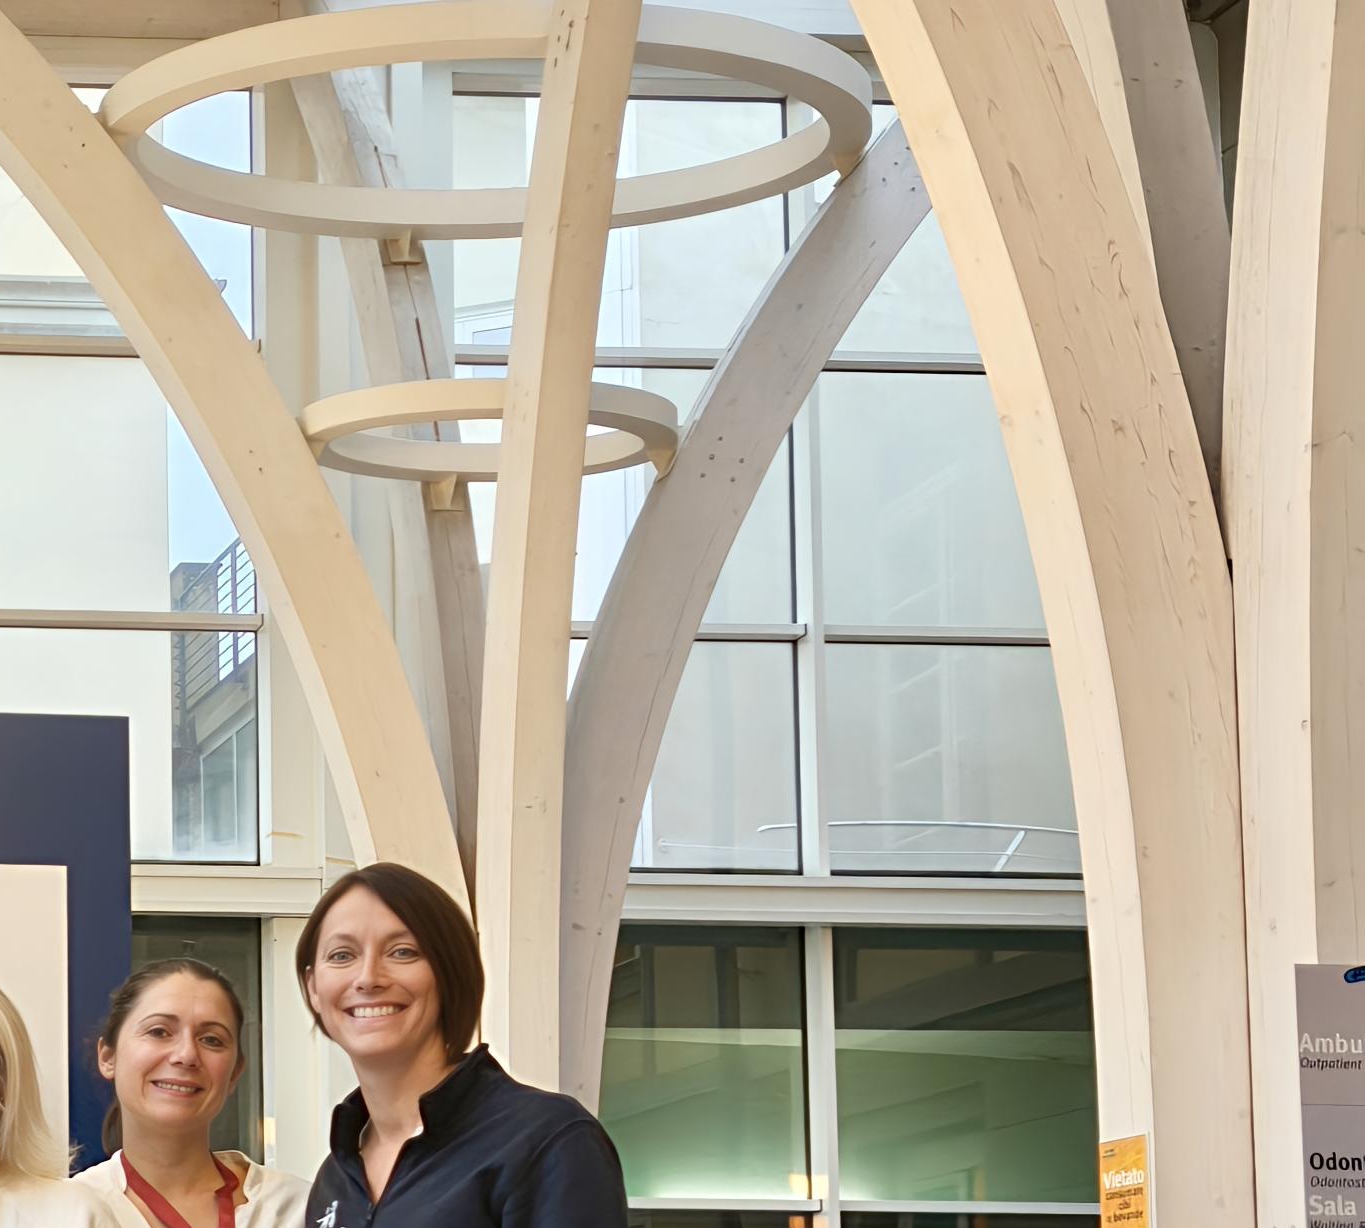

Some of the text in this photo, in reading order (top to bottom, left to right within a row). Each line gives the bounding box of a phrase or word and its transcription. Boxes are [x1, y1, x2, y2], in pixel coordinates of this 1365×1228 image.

[1299, 1033, 1365, 1054] Ambu
[1299, 1057, 1362, 1071] Outpatient
[1103, 1169, 1144, 1189] Vietato
[1309, 1194, 1357, 1216] Sala
